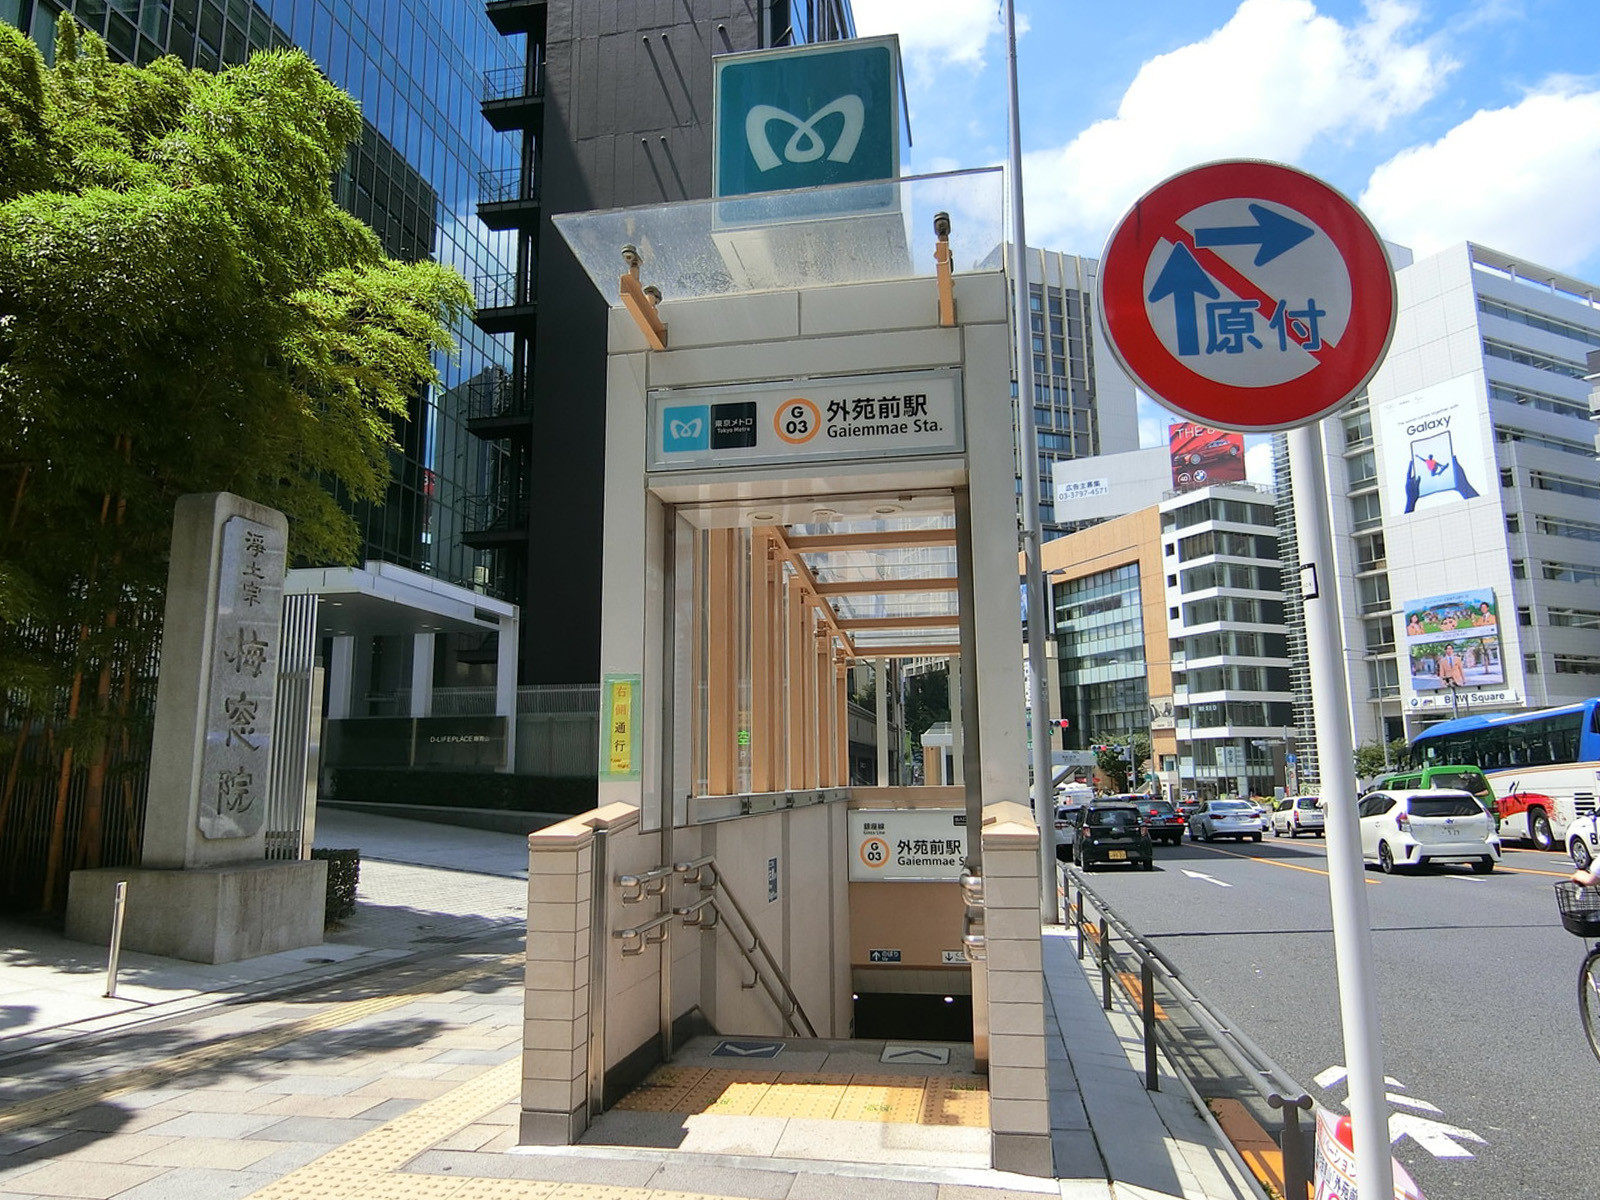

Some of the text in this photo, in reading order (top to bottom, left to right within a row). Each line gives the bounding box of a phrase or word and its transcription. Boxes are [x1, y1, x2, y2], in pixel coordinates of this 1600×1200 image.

[1205, 298, 1327, 355] 原付
[791, 406, 804, 419] G
[826, 395, 928, 422] 外苑前駅
[786, 420, 808, 435] 03
[827, 418, 943, 439] Gaiemmae Sta.
[1175, 425, 1203, 439] THE
[1406, 415, 1451, 436] Galaxy
[1471, 692, 1505, 704] Square
[614, 685, 627, 752] 右側通行
[870, 842, 879, 851] G
[897, 840, 961, 856] 外苑前駅
[867, 852, 882, 861] 03
[898, 856, 955, 866] Gaiemmae
